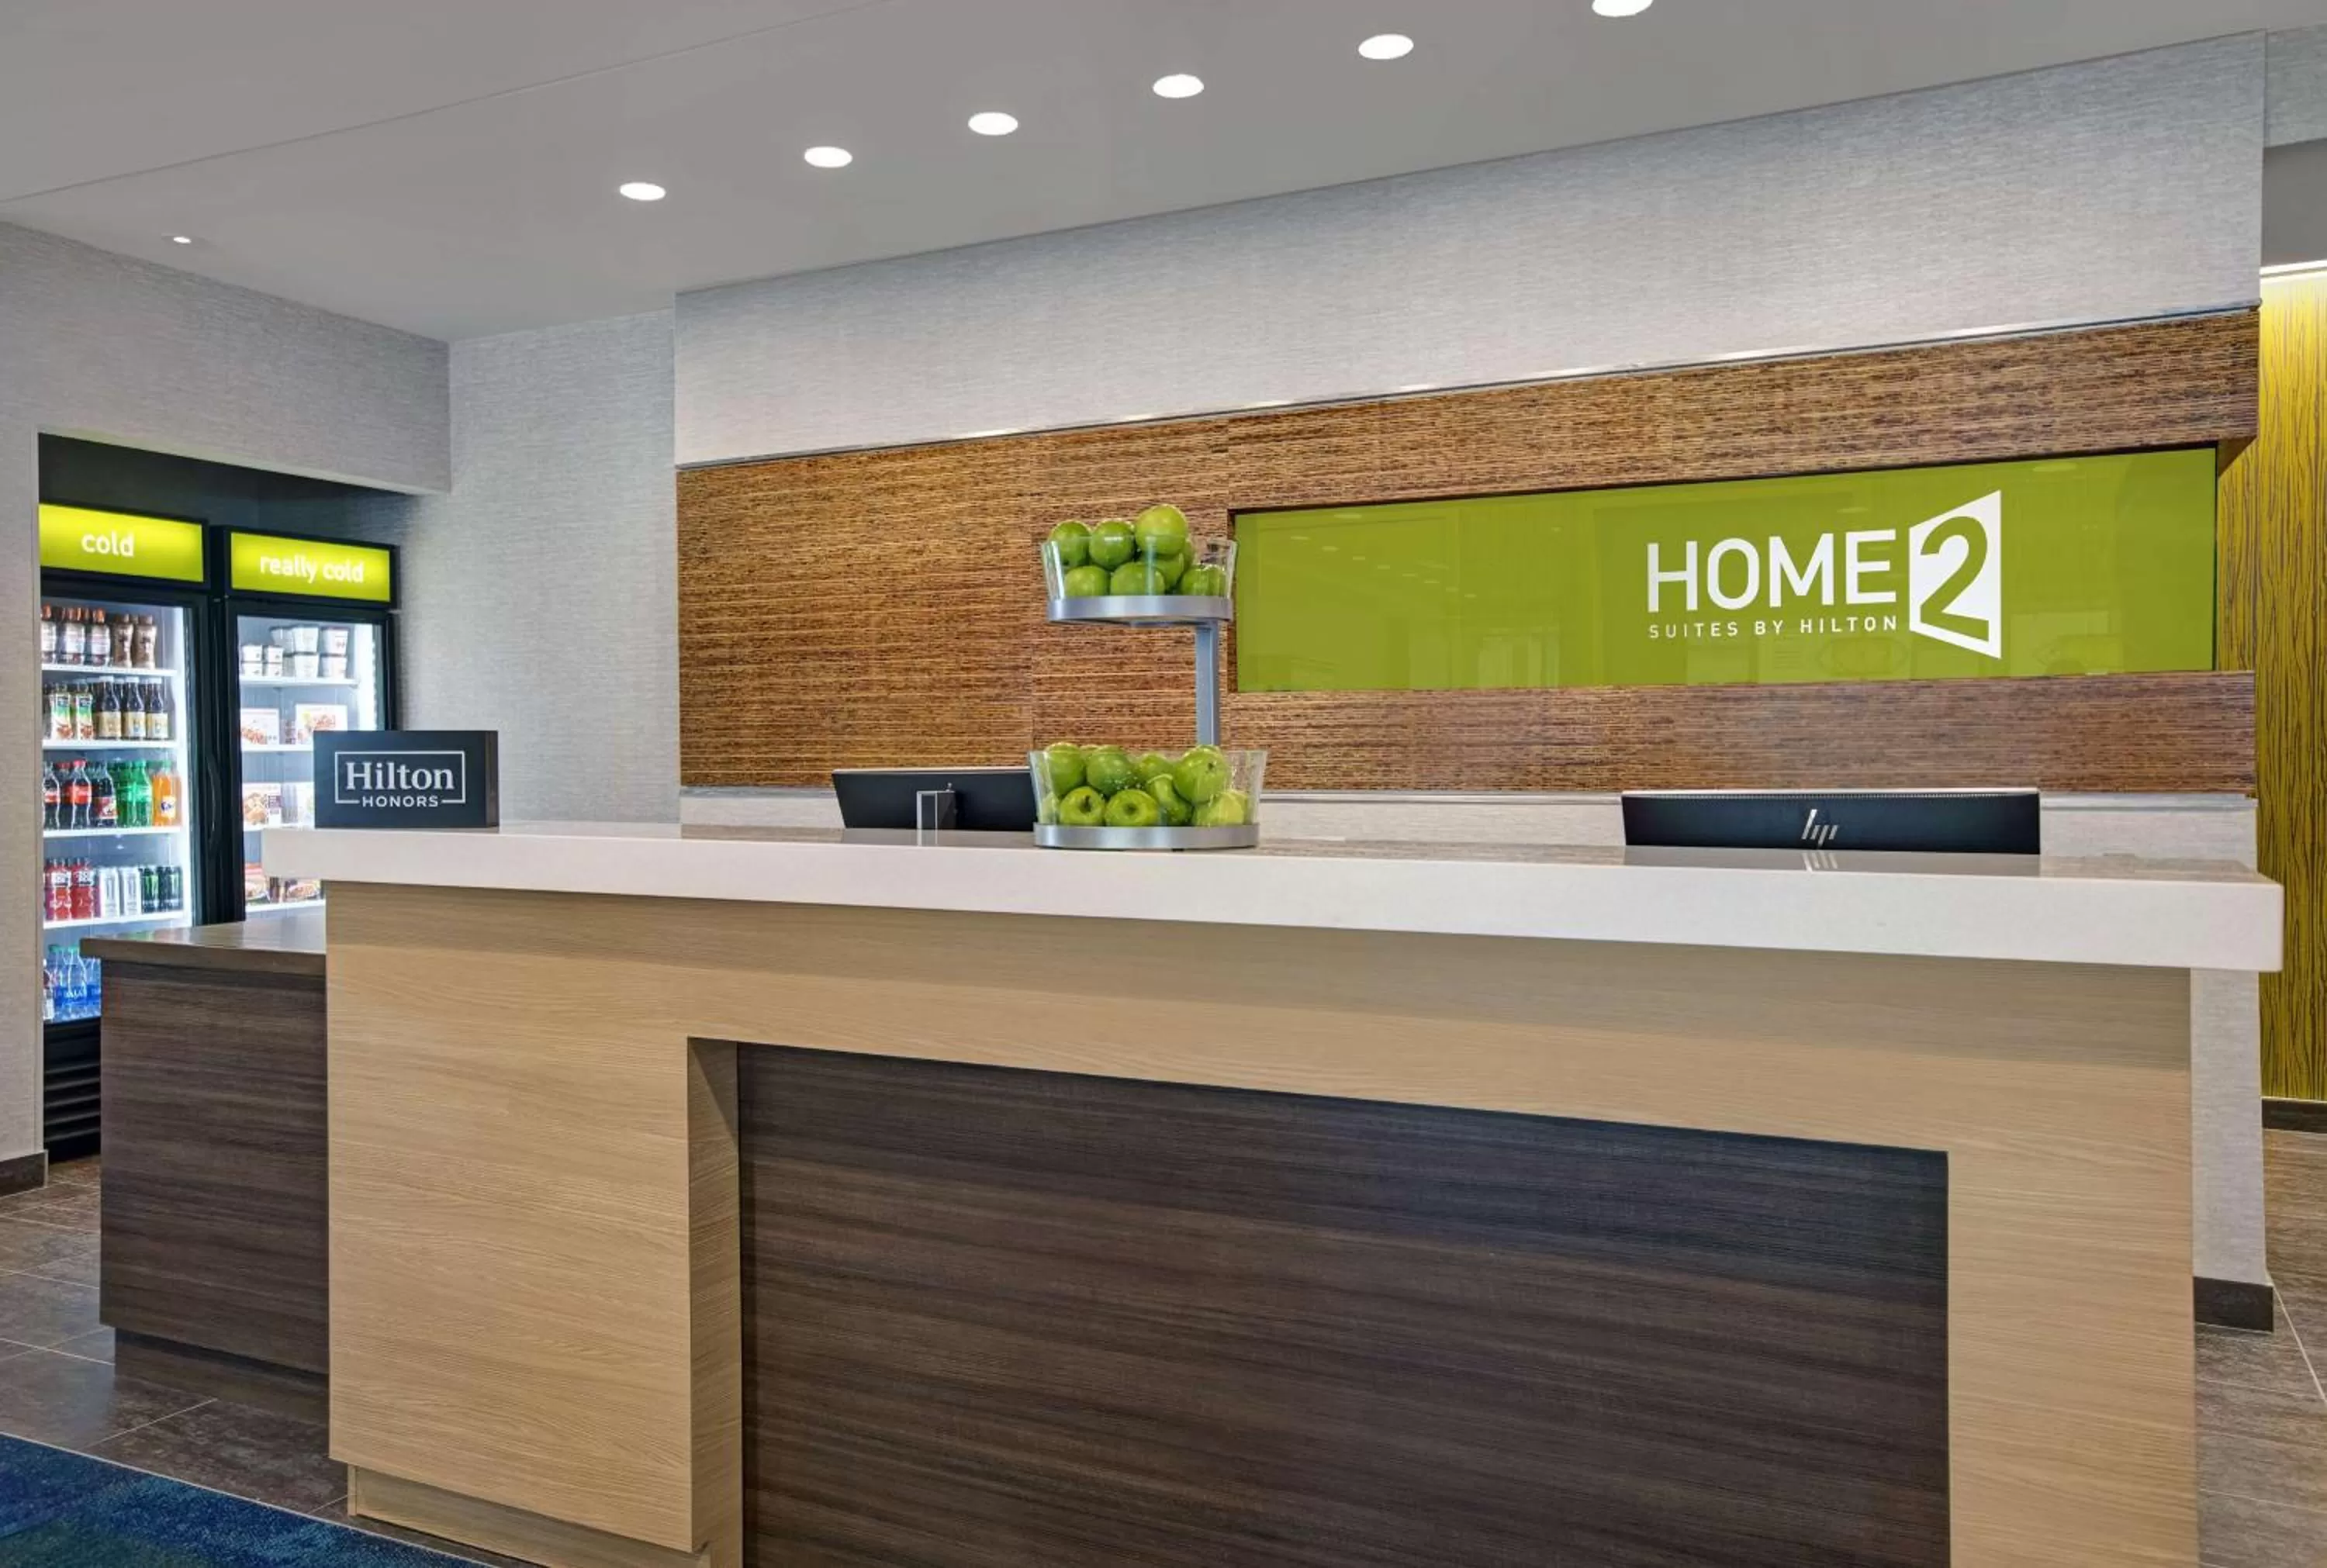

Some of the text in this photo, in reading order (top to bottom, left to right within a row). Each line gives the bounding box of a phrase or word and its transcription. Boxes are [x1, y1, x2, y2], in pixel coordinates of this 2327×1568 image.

[81, 530, 135, 558] cold
[260, 554, 365, 584] really cold
[1647, 528, 1897, 613] HOME
[1648, 616, 1897, 639] SUITES BY HILTON
[345, 761, 455, 790] Hilton
[362, 795, 439, 808] HONORS
